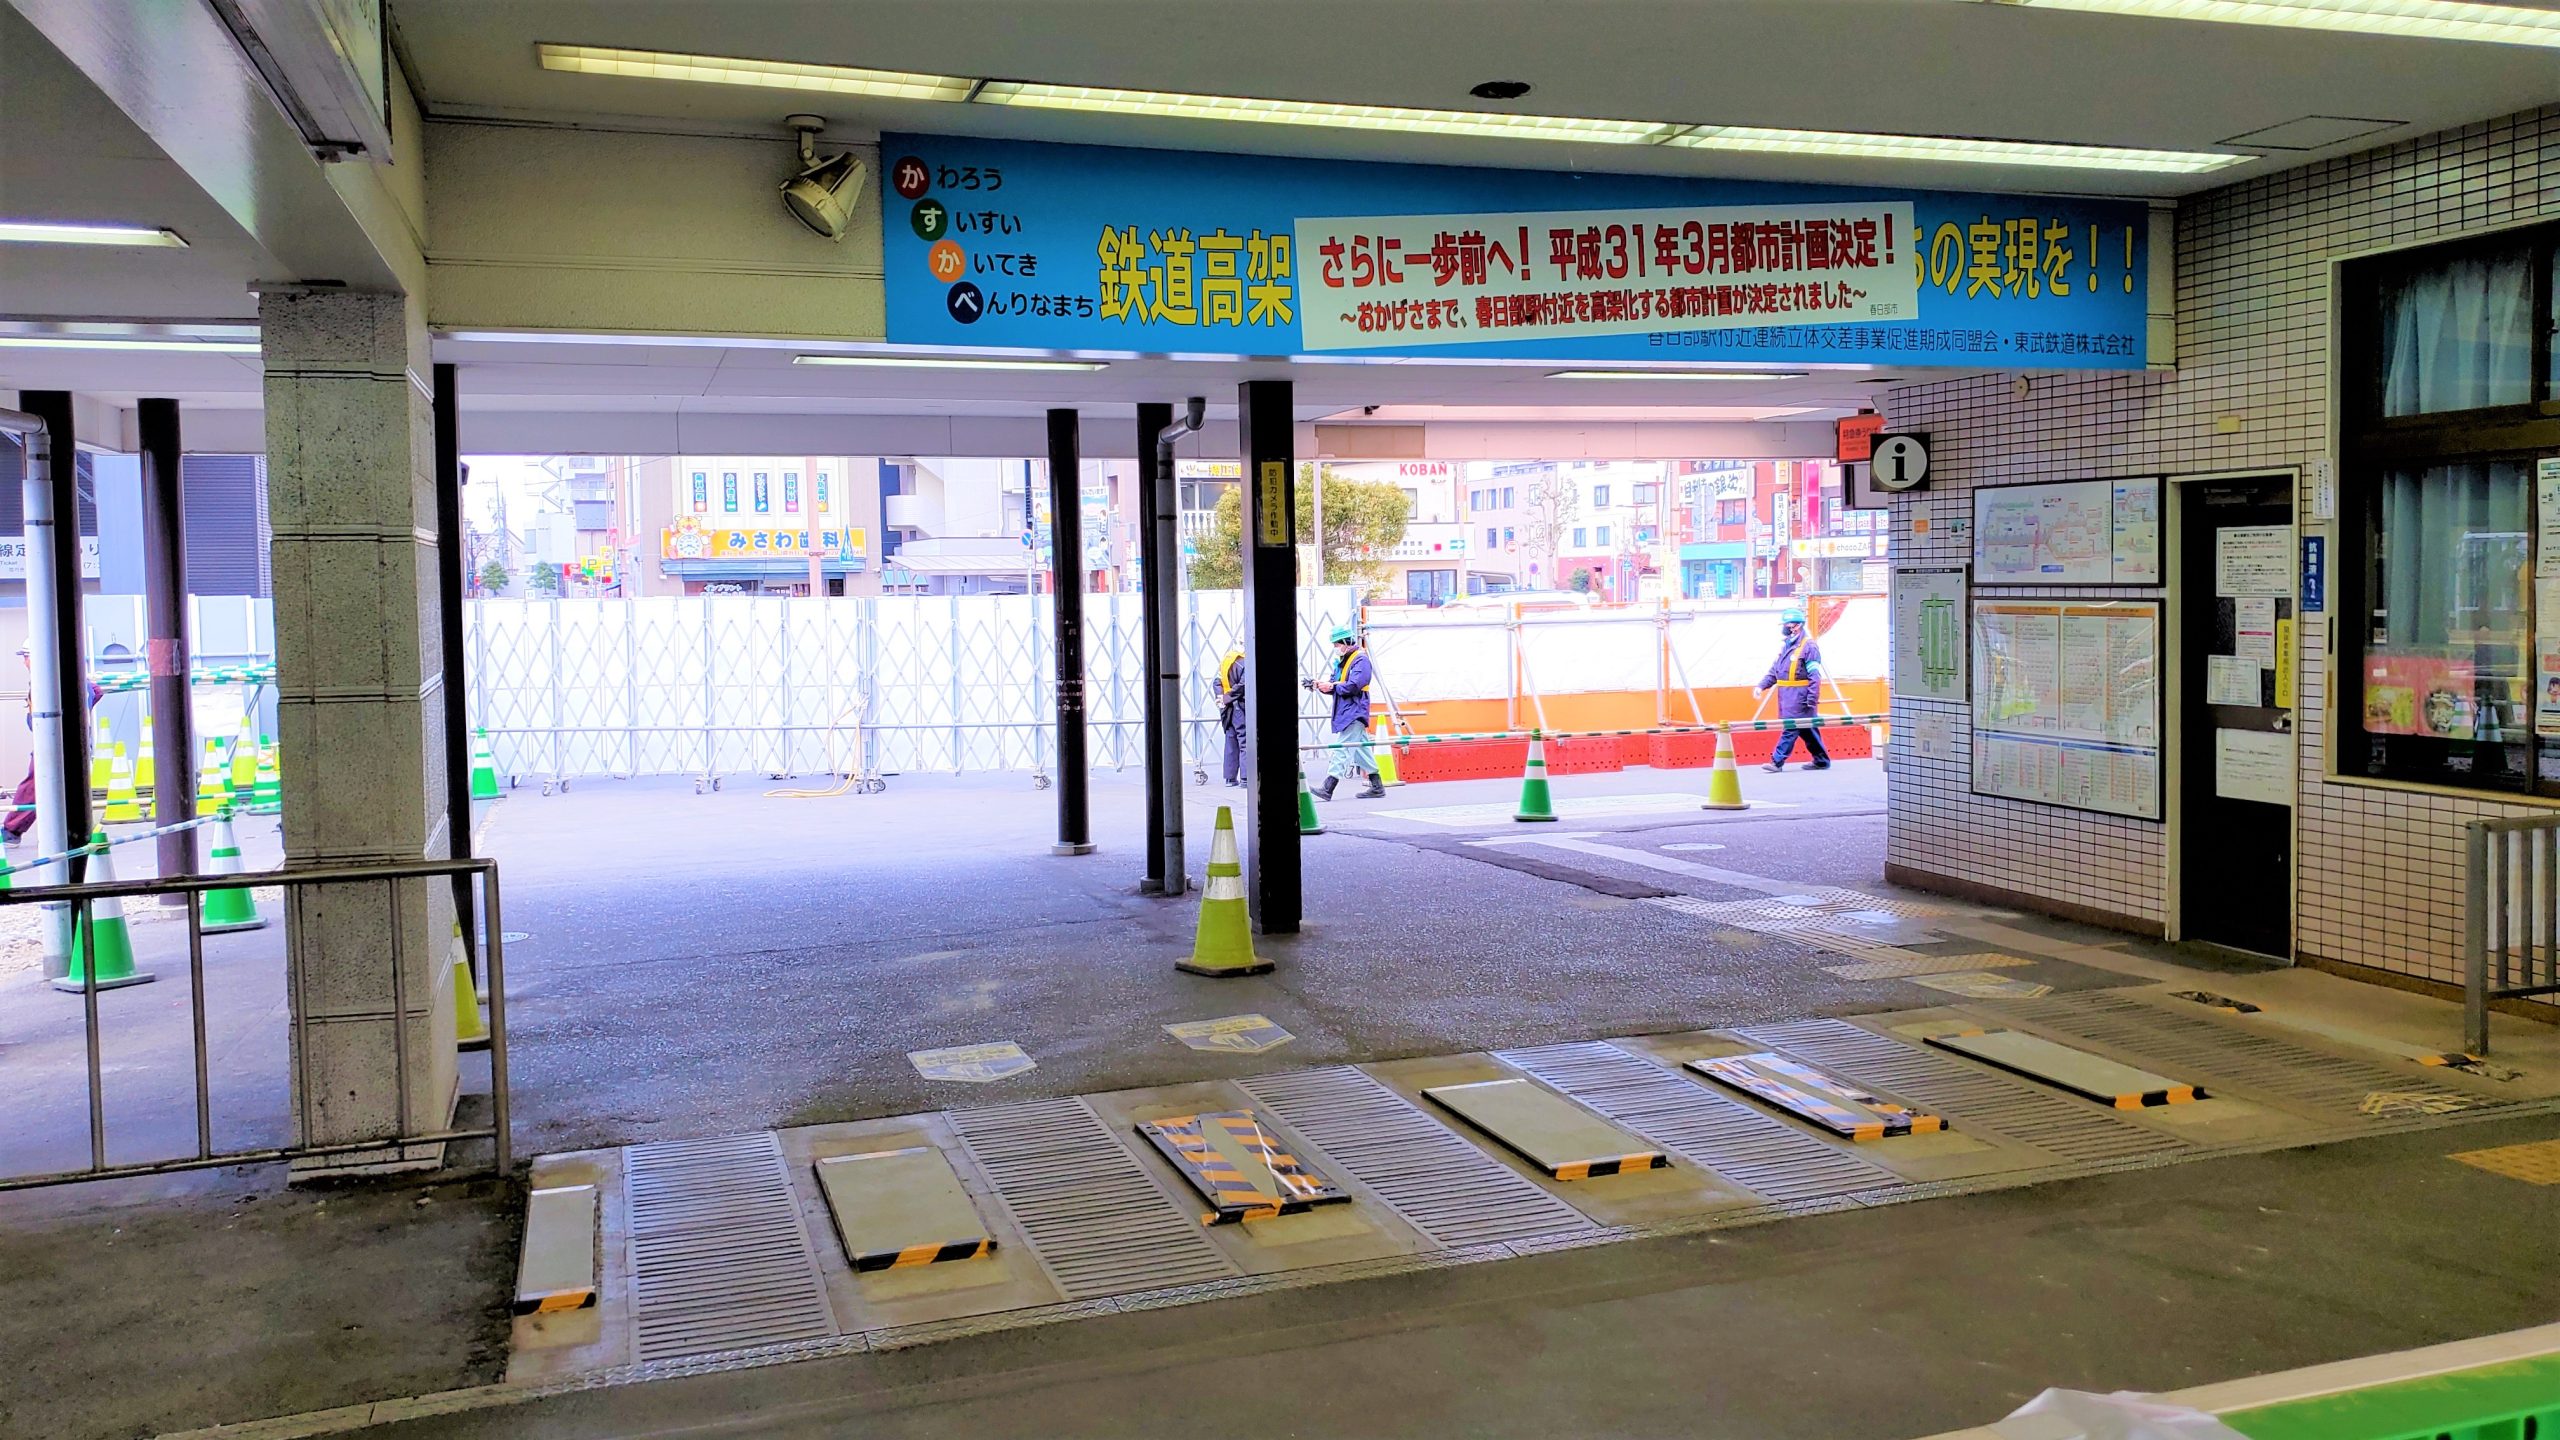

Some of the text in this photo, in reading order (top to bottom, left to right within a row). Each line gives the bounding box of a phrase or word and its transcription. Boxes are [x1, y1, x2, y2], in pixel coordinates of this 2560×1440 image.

[1097, 224, 1293, 327] 鉄道高架
[1319, 225, 1531, 287] さらに一歩前へ！
[1869, 303, 1899, 316] 春日部市
[1400, 463, 1447, 476] KOBAN
[1268, 468, 1279, 537] 防犯カメラ作動中
